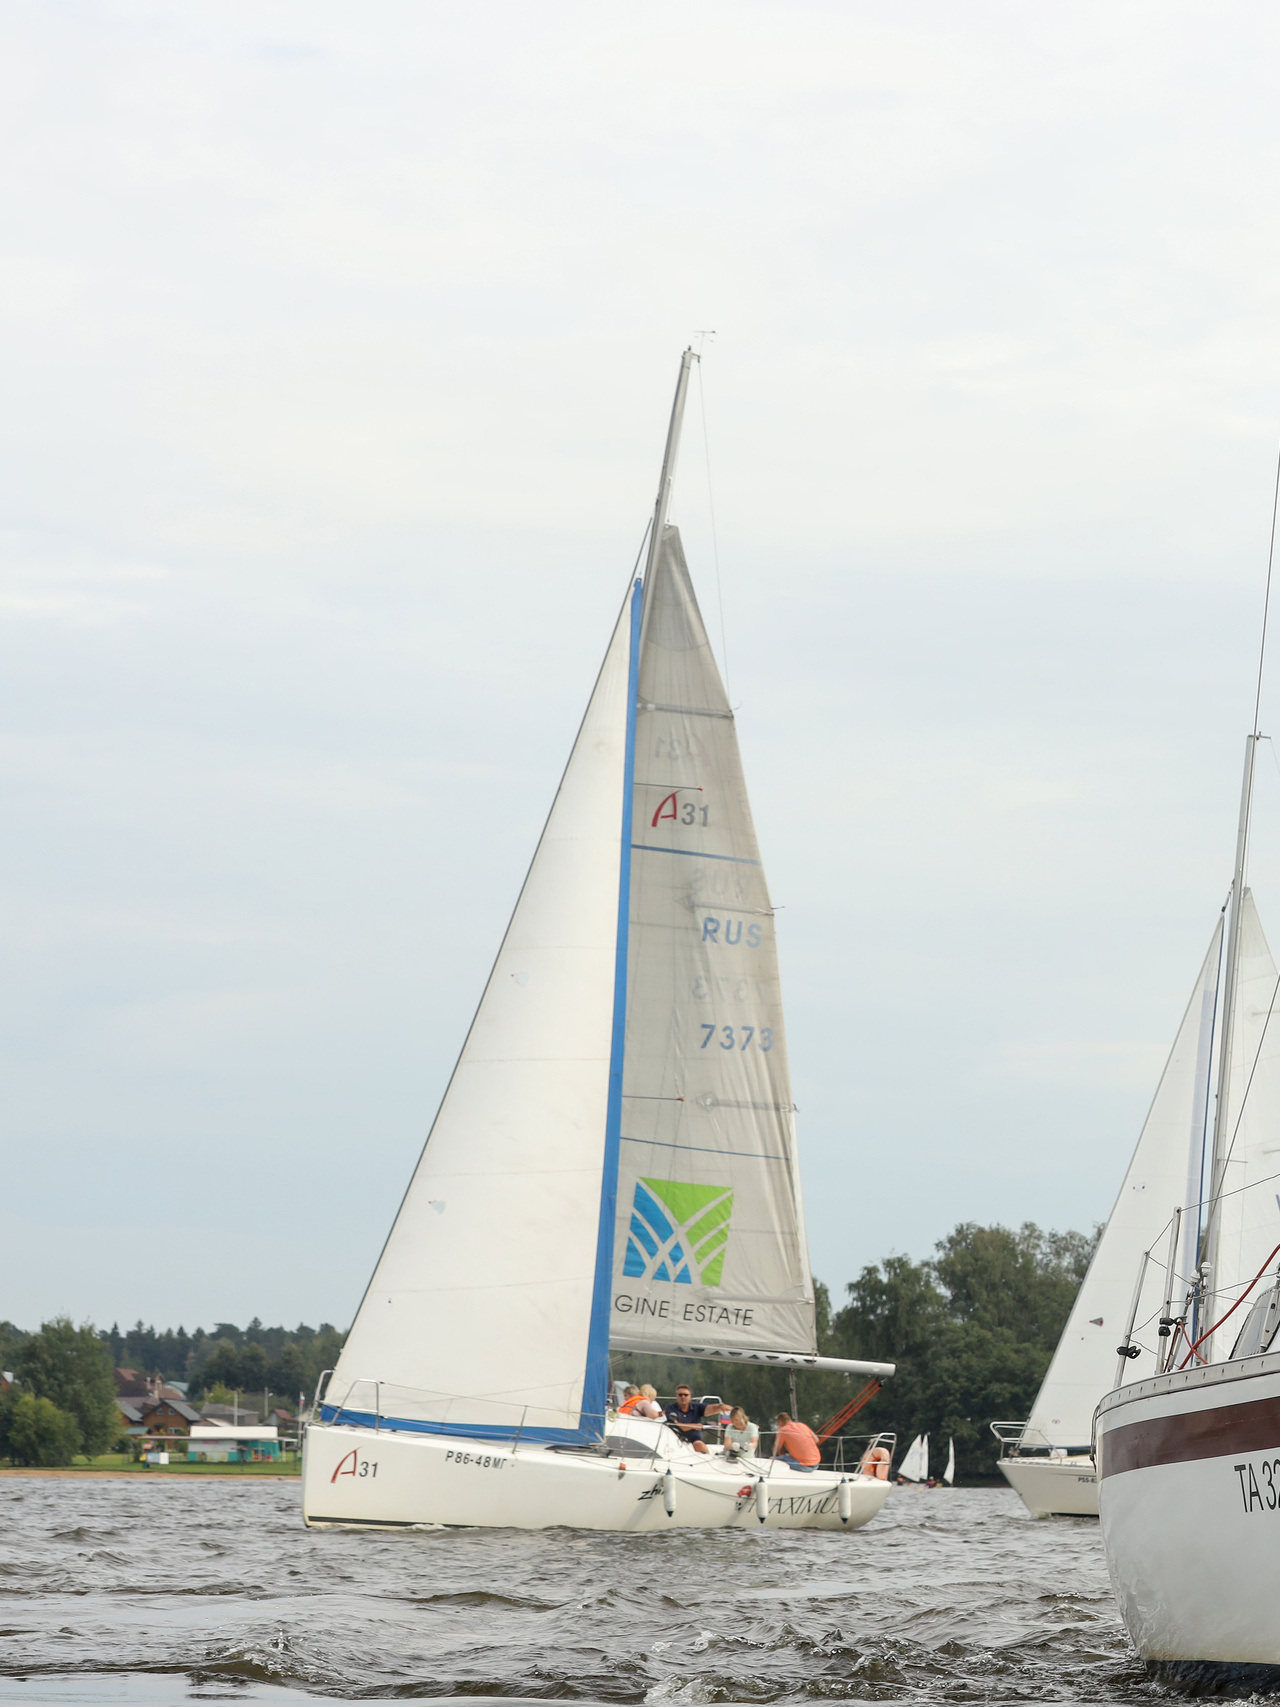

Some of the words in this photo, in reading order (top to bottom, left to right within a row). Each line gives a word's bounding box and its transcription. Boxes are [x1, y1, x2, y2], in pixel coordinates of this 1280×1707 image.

[651, 789, 709, 828] A31
[701, 917, 763, 949] RUS
[700, 1023, 774, 1053] 7373
[683, 1303, 754, 1327] ESTATE
[330, 1446, 378, 1483] A31
[1234, 1463, 1264, 1513] TA
